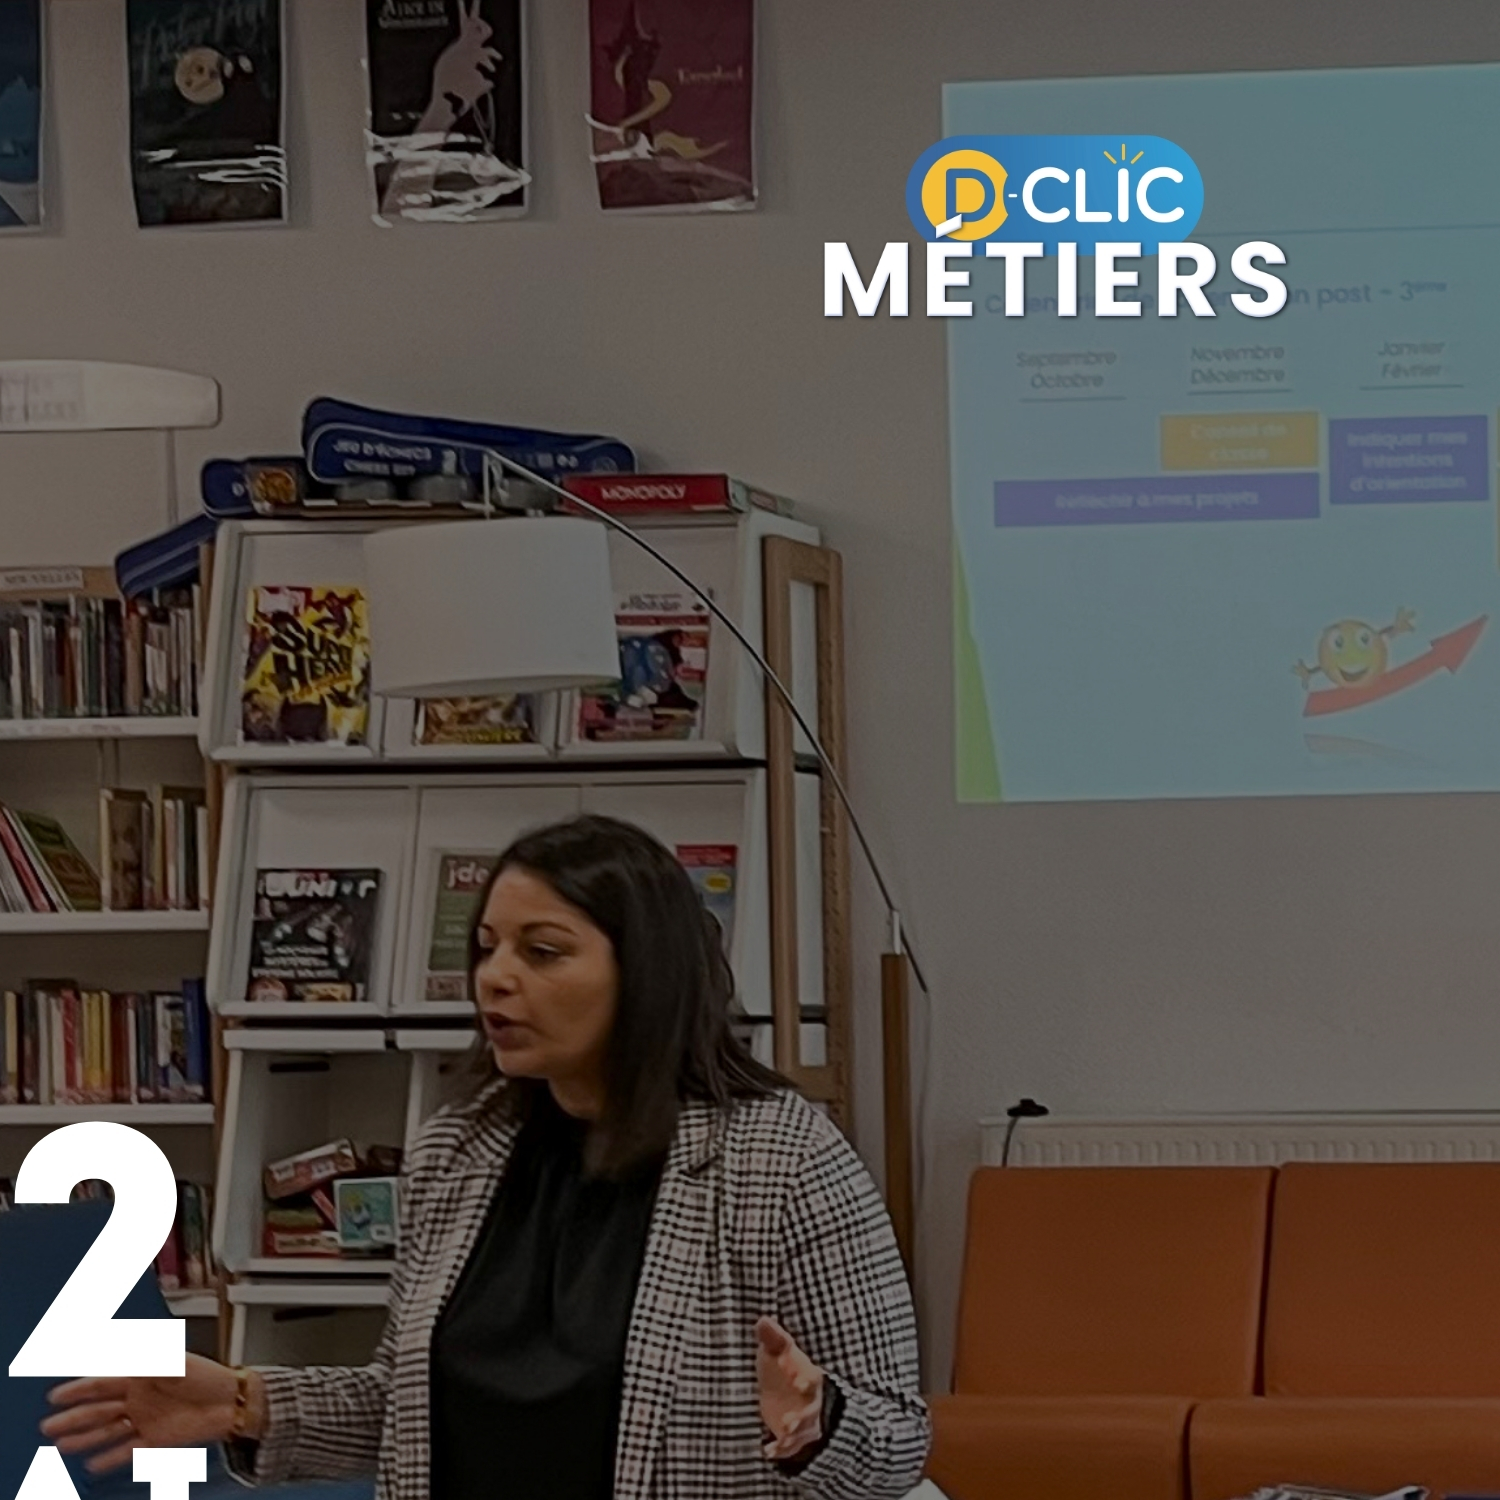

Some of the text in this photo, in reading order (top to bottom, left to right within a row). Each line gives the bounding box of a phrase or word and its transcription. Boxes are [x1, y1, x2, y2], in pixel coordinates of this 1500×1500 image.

[1317, 284, 1372, 312] post
[1190, 346, 1285, 363] Novembre
[1030, 372, 1105, 389] Octobre
[1190, 367, 1286, 384] Décembre
[600, 484, 688, 502] MONOPOLY
